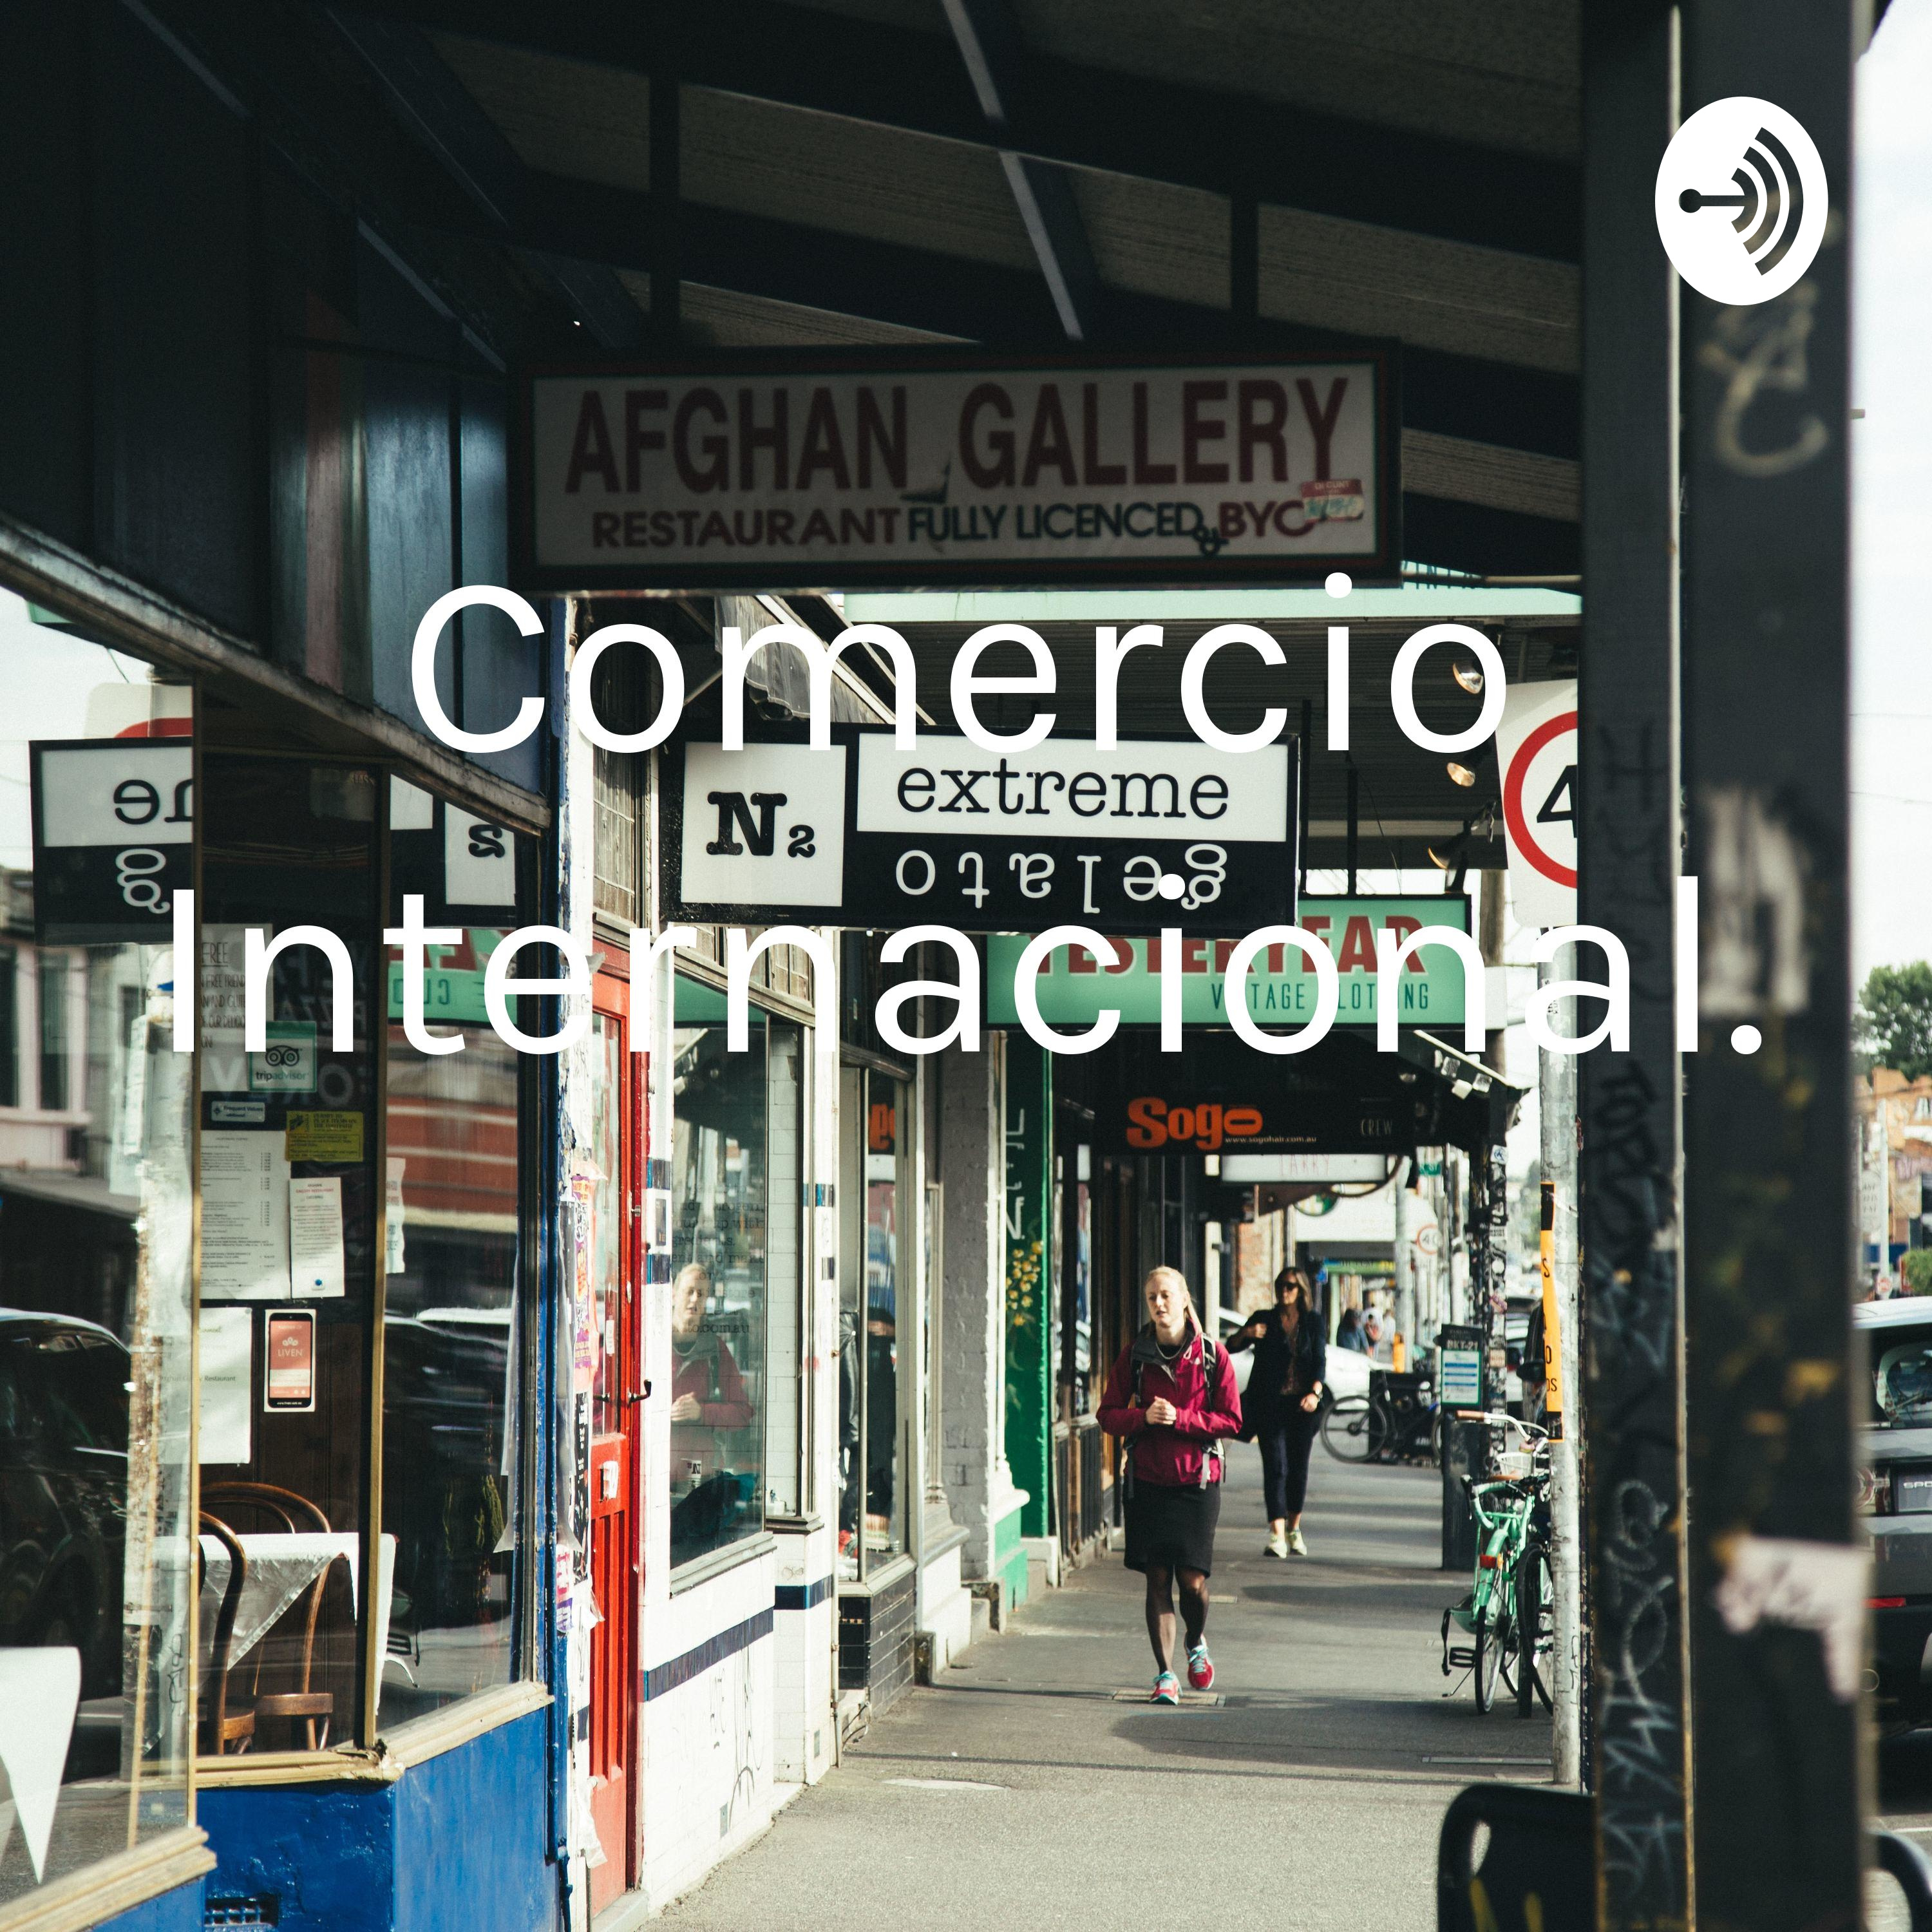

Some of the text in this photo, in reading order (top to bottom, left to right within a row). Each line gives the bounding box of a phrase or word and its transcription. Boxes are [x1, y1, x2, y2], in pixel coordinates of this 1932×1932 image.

[564, 377, 1349, 494] AFGHAN GALLERY
[592, 507, 901, 548] RESTAURANT
[908, 504, 1007, 543] FULLY
[1017, 501, 1204, 540] LICENCED
[897, 758, 1230, 820] extreme
[895, 844, 1229, 914] gelato
[1211, 983, 1429, 1010] VTAGE LOTNG
[256, 1071, 307, 1082] tripadvisor
[1126, 1097, 1263, 1150] Sogo
[1359, 1118, 1393, 1137] CREW
